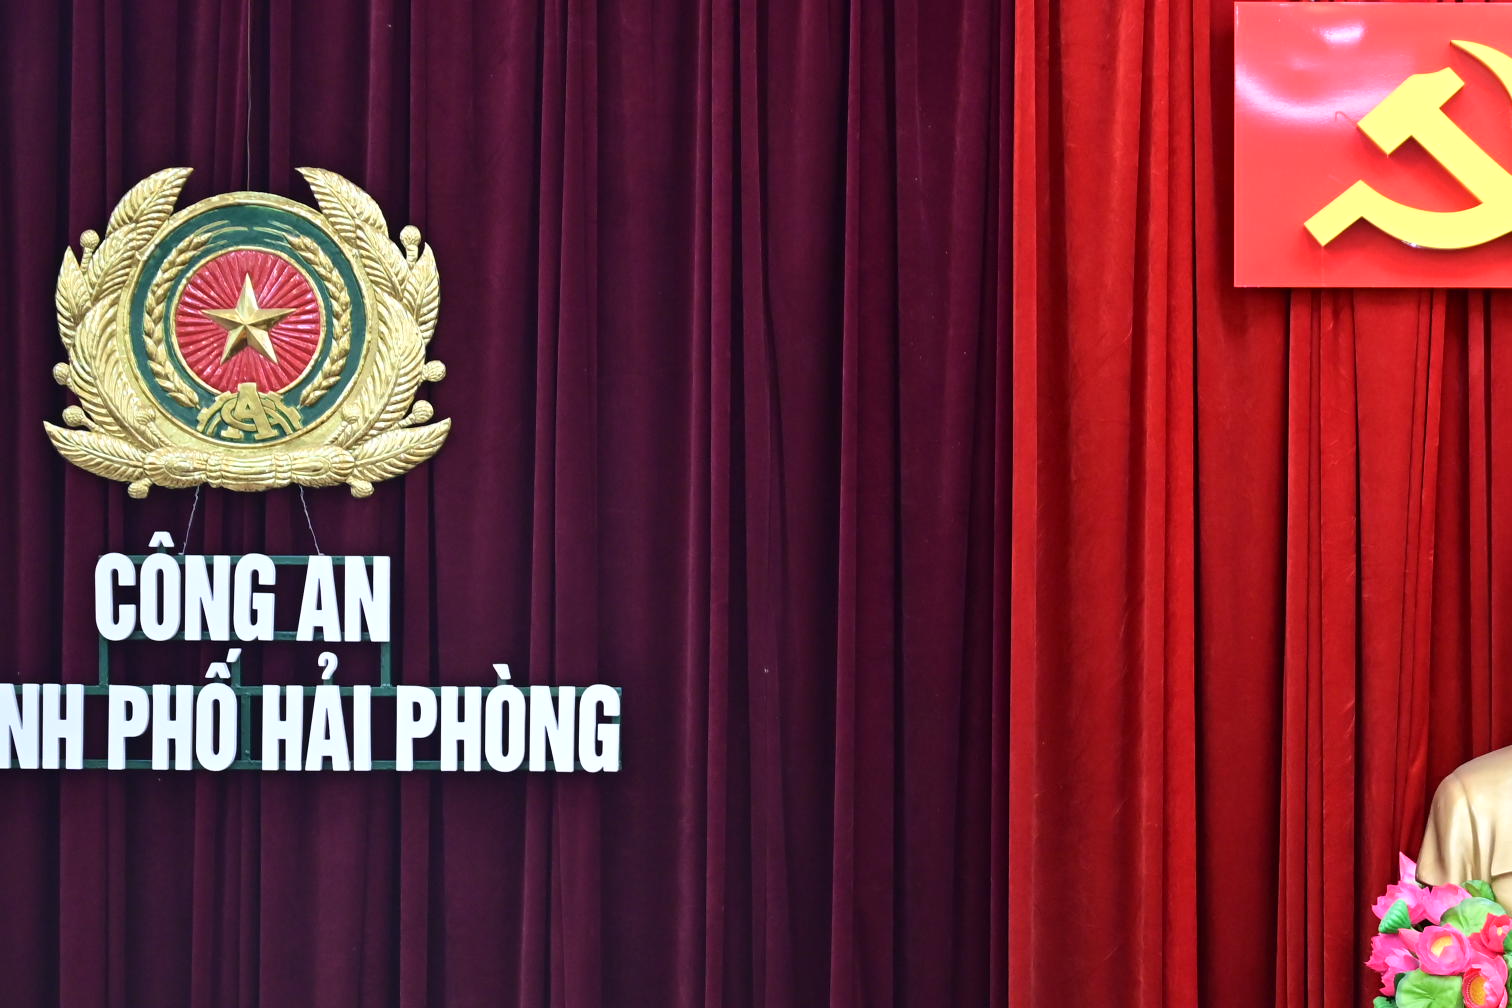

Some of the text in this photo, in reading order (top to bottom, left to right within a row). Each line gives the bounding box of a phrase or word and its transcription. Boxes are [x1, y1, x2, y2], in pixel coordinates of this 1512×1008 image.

[94, 531, 391, 642] CÔNG AN
[0, 647, 622, 772] NH PHỐ HẢI PHÒNG
